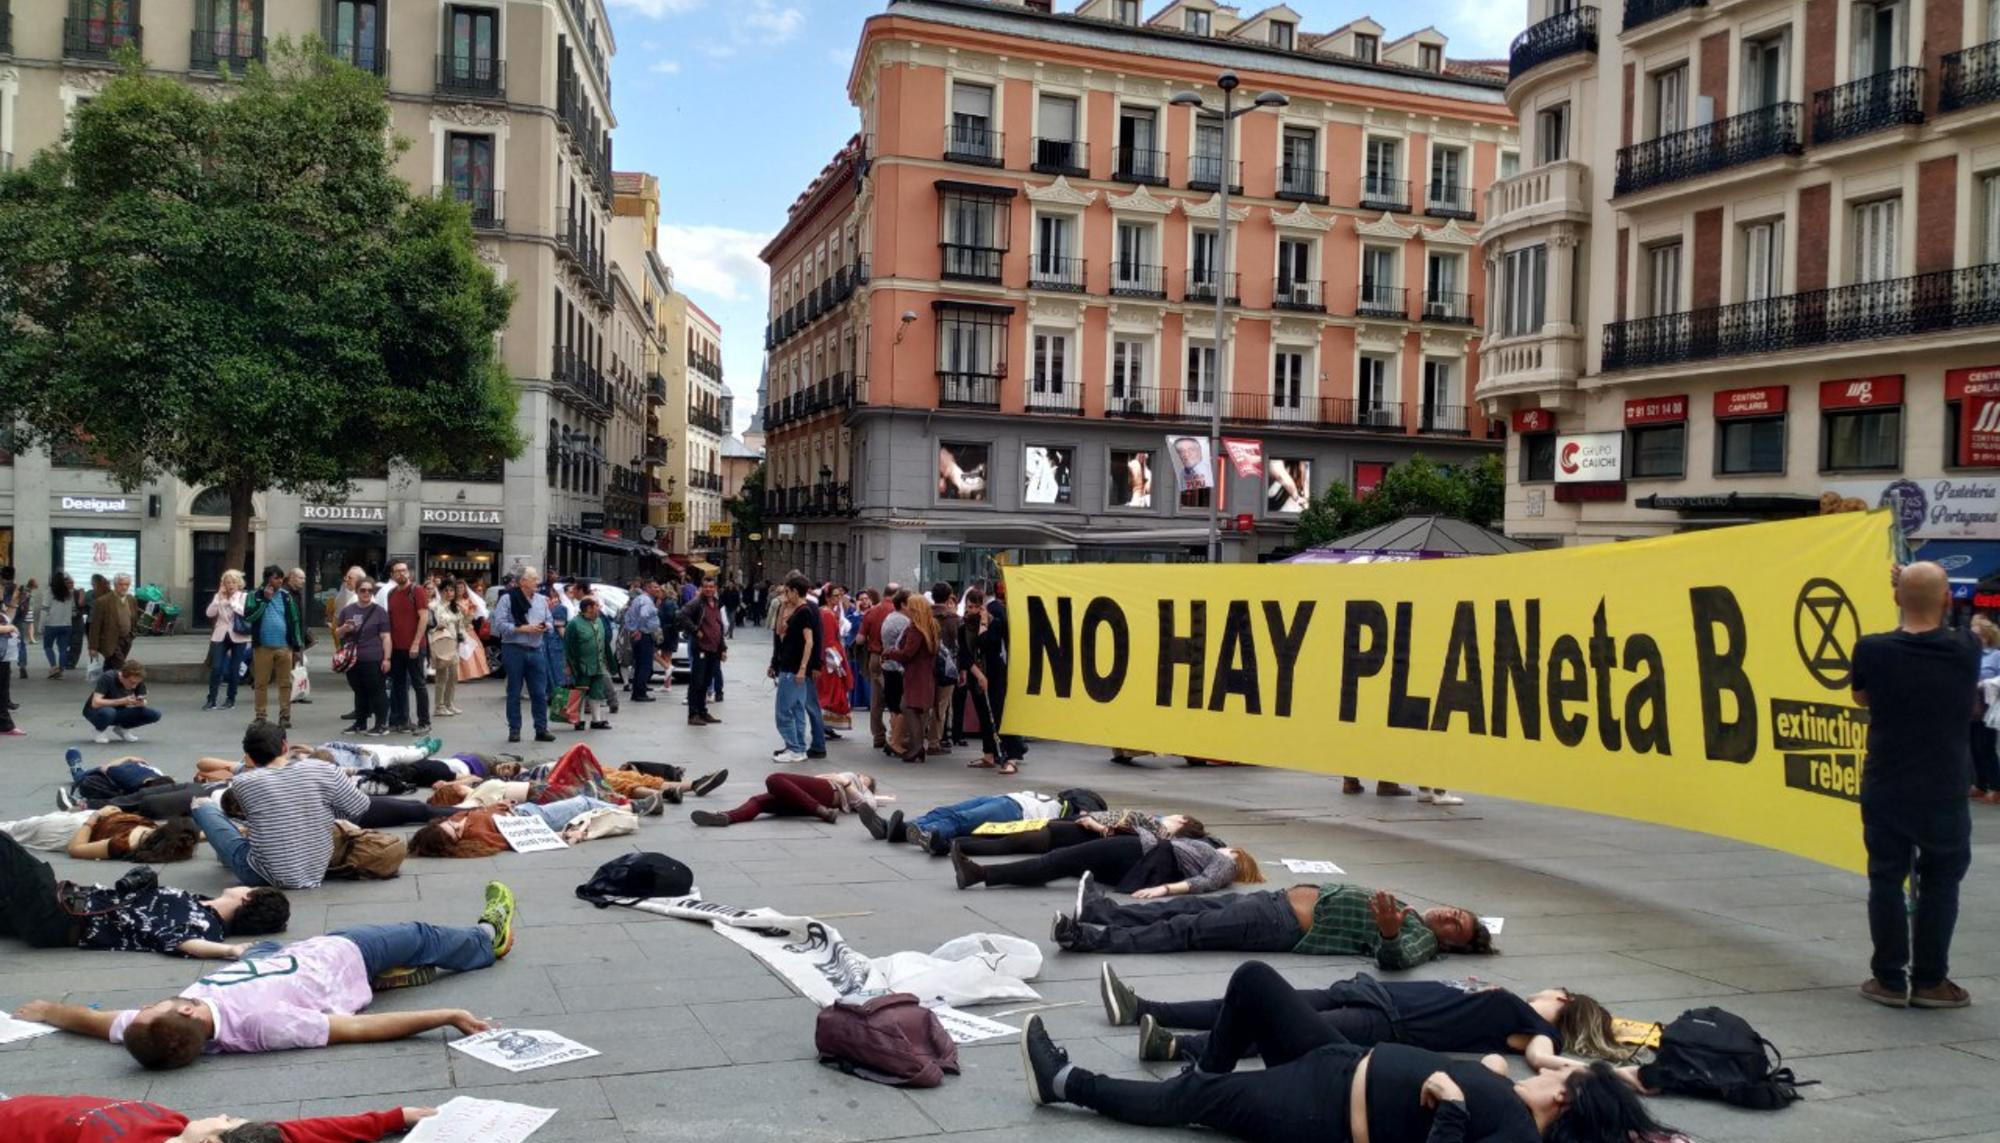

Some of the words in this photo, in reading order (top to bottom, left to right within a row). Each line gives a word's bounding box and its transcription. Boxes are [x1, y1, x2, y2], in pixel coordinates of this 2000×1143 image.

[1731, 391, 1766, 402] CENTROS
[1728, 401, 1768, 412] CAPILARES
[1583, 445, 1612, 457] GRUPO
[1933, 480, 1996, 501] Pastelería
[62, 497, 126, 513] Desigual
[304, 506, 385, 520] RODILLA
[423, 509, 501, 523] RODILLA
[1931, 505, 1998, 526] Portuguesa
[1026, 595, 1130, 704] NO
[1155, 599, 1318, 718] HAY
[1338, 593, 1673, 757] PLANeta
[1689, 585, 1758, 764] B
